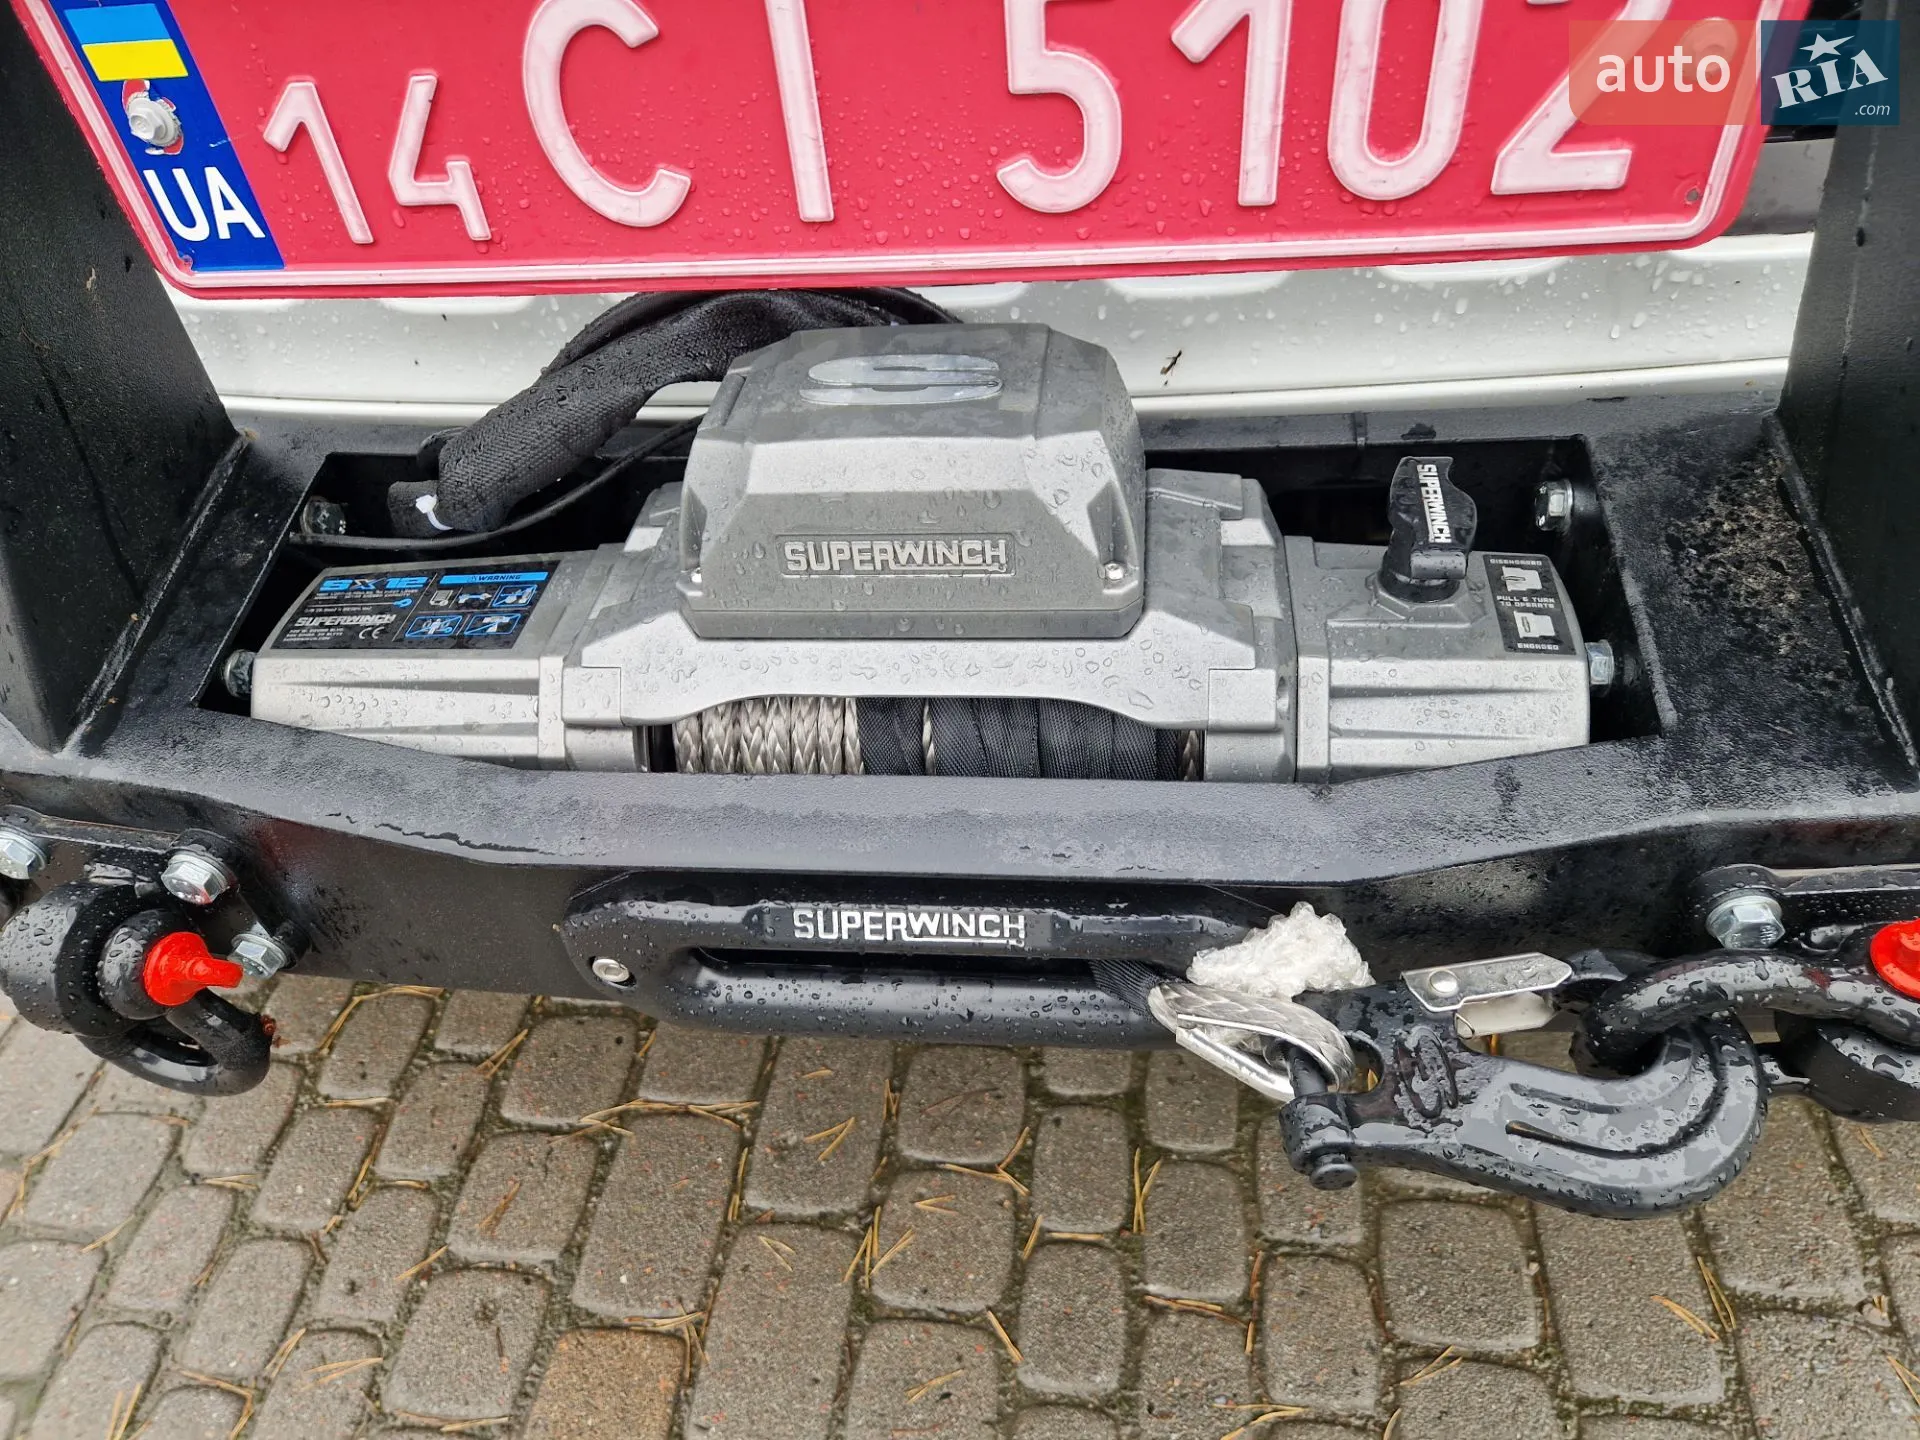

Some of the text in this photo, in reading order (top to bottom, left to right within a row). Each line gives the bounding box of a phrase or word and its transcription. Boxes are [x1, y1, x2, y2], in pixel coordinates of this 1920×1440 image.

[142, 164, 266, 243] UA
[1416, 464, 1452, 543] SUPERWINCH
[784, 539, 1007, 573] SUPERWINCH
[294, 613, 397, 627] SUPERWINCH
[358, 626, 385, 640] CE
[1517, 642, 1560, 650] ENGAGED
[792, 908, 1026, 947] SUPERWINCH
